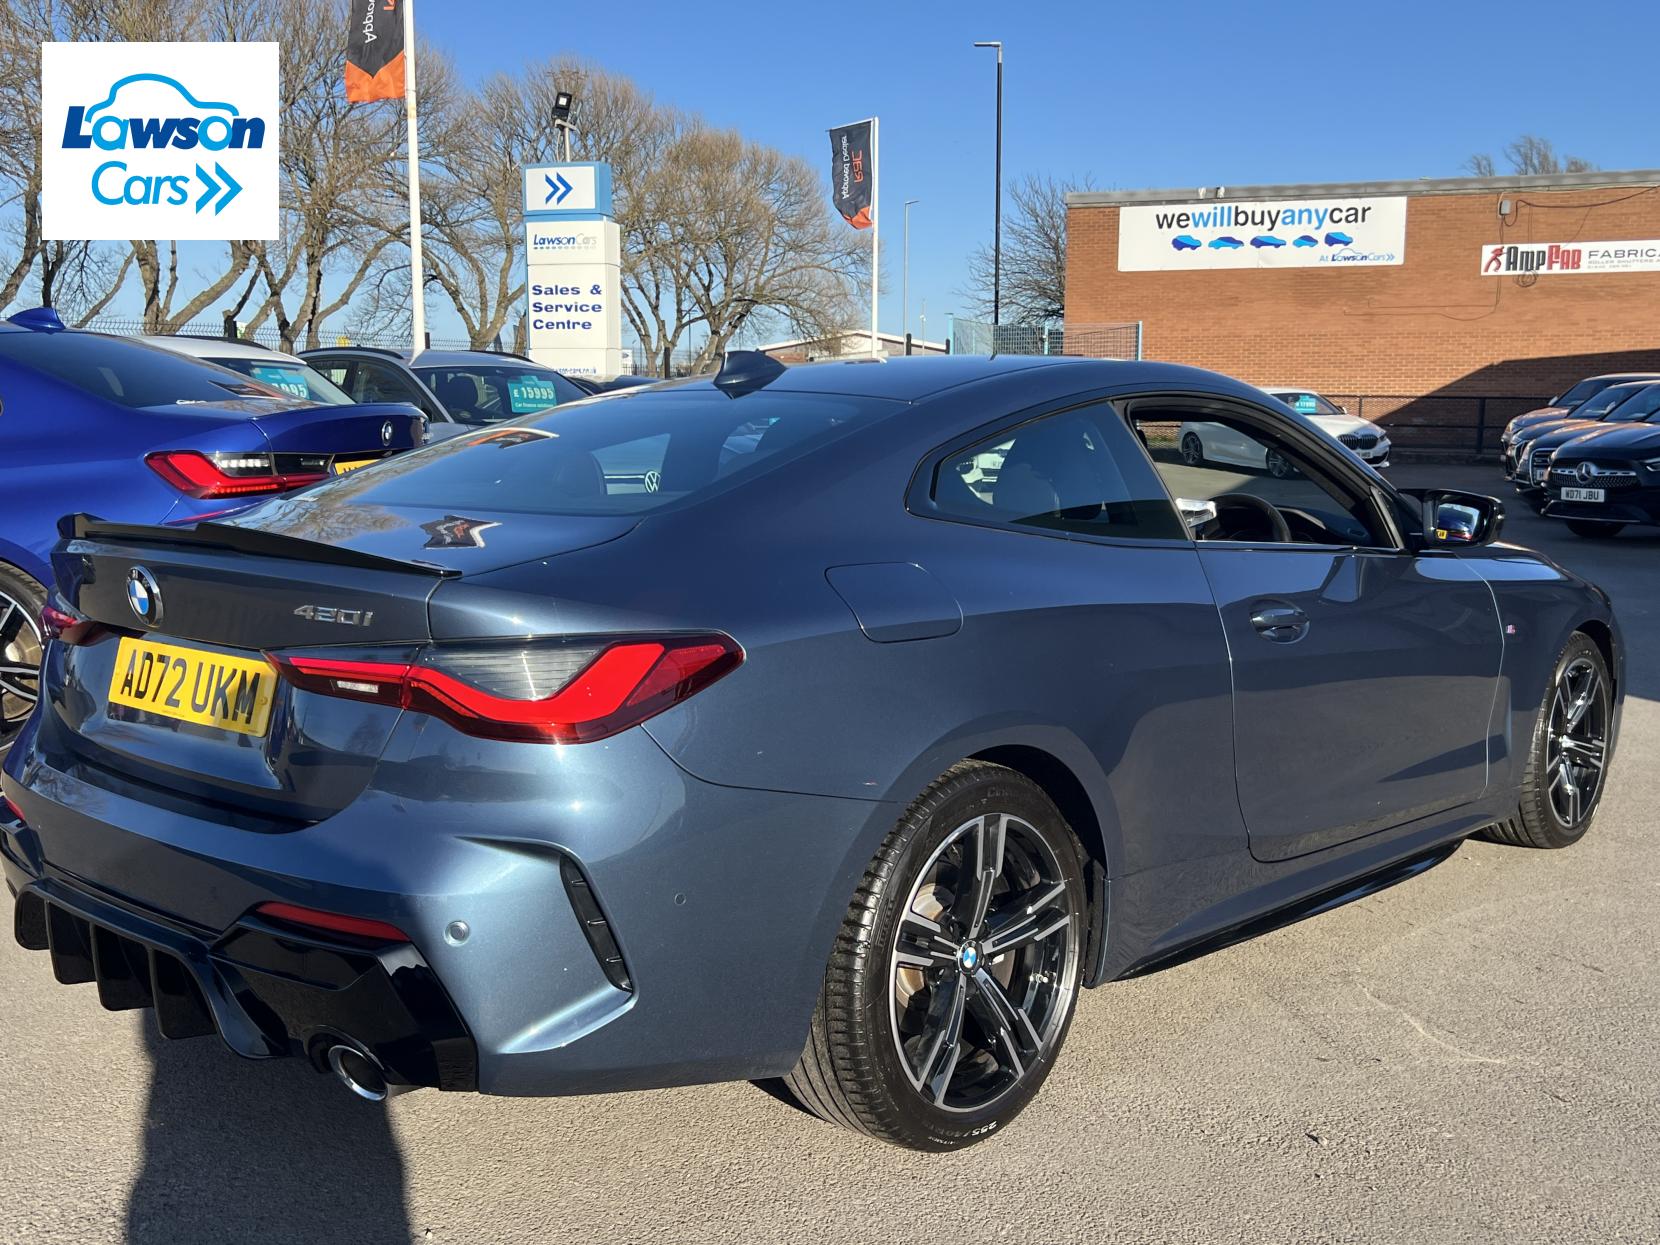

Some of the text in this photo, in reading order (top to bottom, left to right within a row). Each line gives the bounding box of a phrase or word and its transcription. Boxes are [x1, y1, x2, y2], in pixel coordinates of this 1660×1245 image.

[1155, 205, 1372, 232] wewillbuyanycar
[1588, 248, 1660, 259] FABRIC
[532, 284, 603, 296] Sales &
[532, 302, 603, 313] Service
[533, 319, 593, 331] Centre
[120, 649, 261, 725] AD72 UKM
